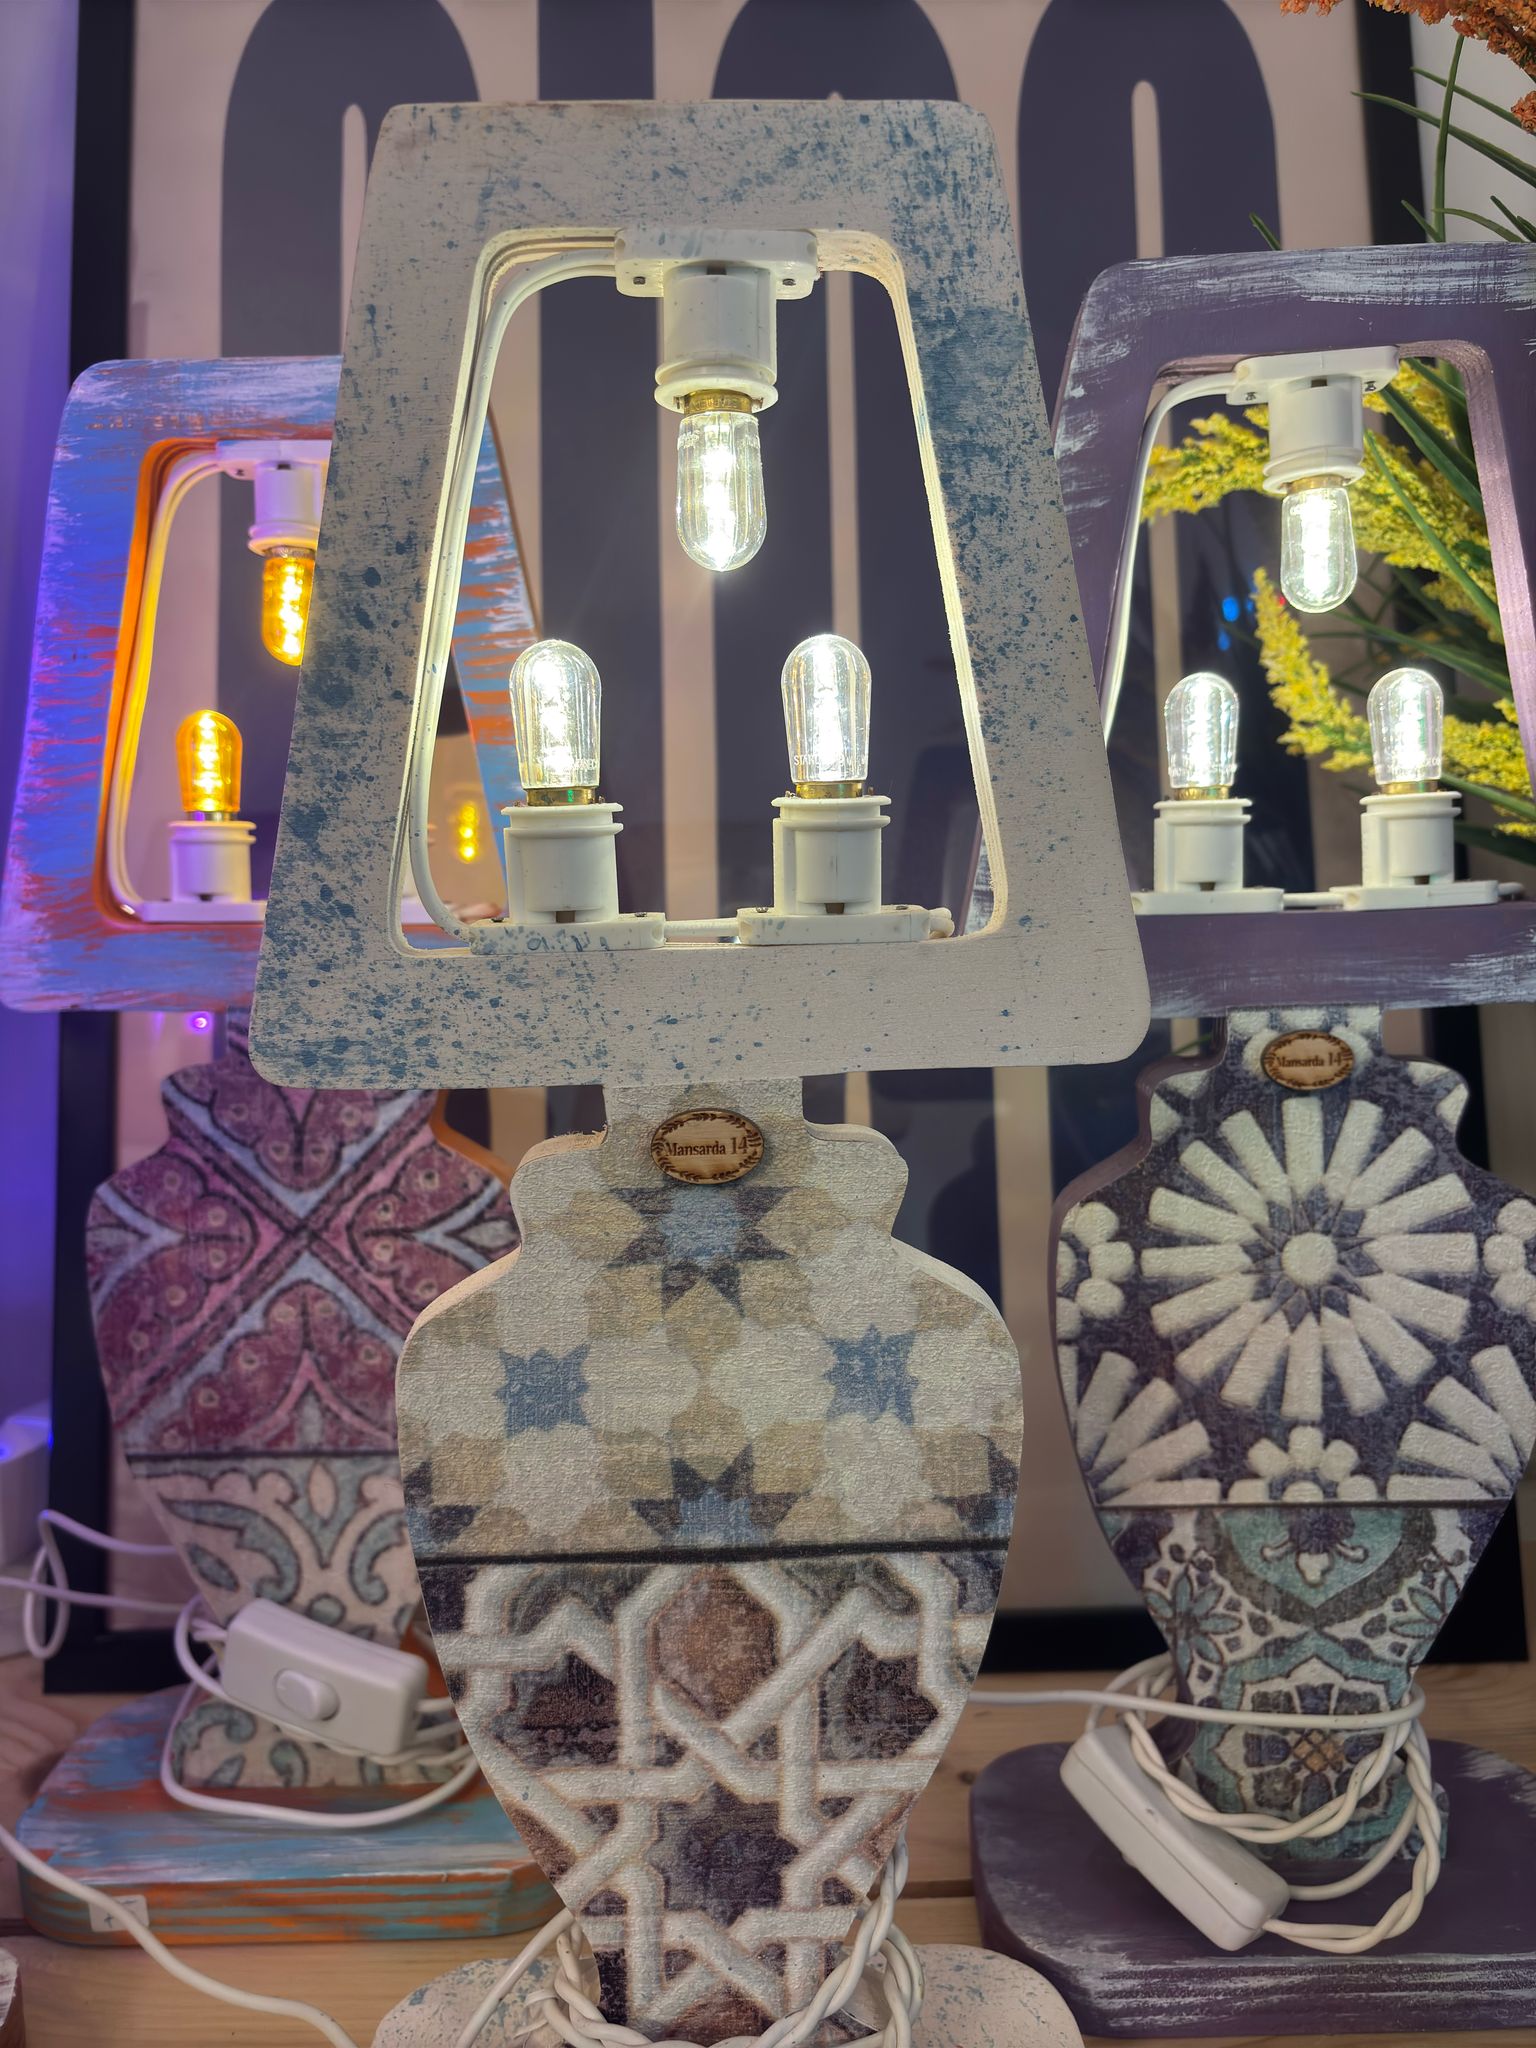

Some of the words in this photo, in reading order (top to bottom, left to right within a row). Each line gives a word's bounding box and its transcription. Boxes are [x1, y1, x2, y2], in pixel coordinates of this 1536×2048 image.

[1276, 1055, 1325, 1068] Mansarda
[1328, 1051, 1342, 1066] 14
[665, 1141, 726, 1156] Mansarda
[730, 1136, 749, 1155] 14
